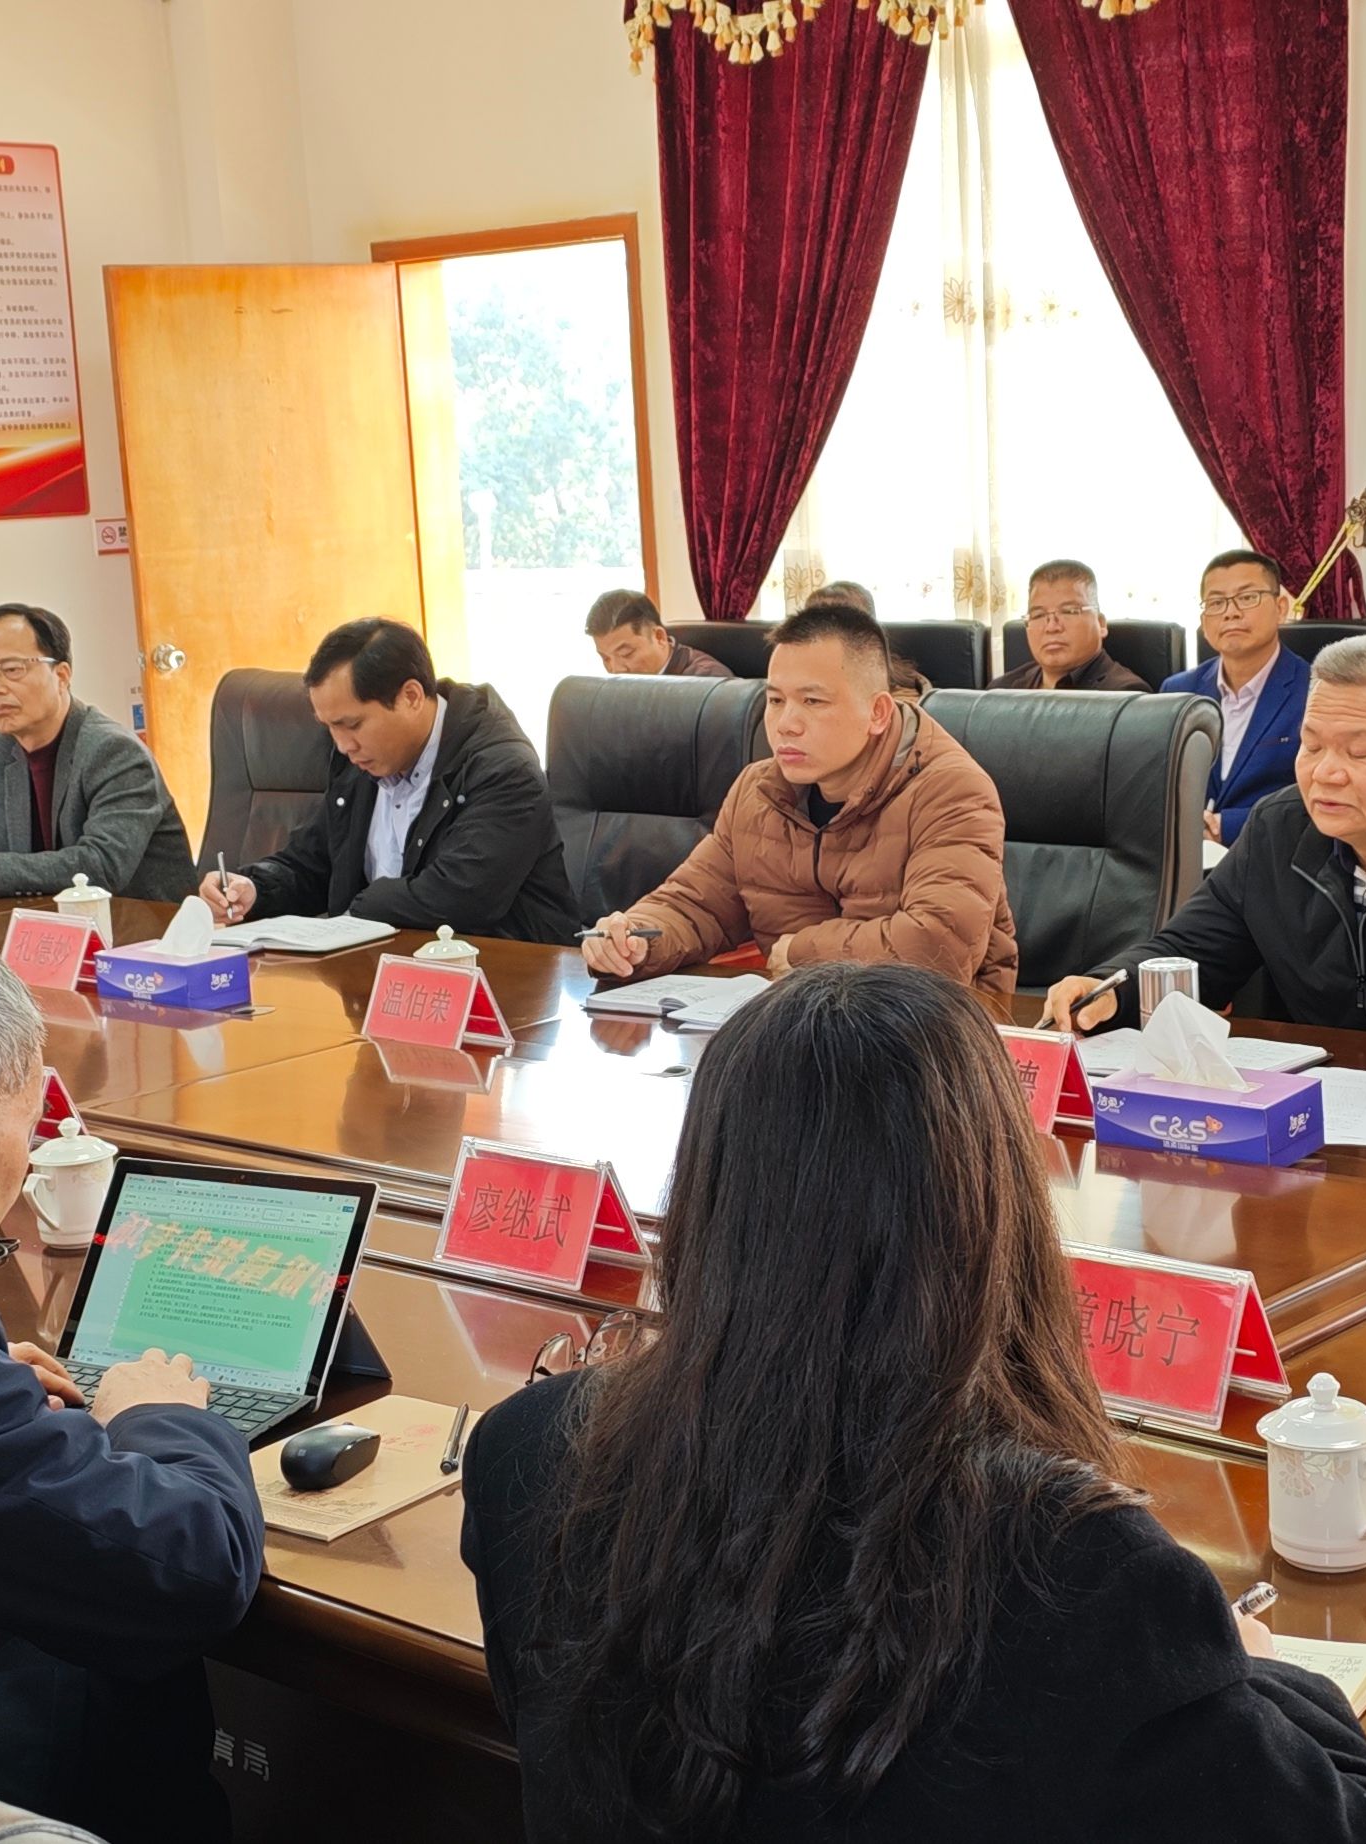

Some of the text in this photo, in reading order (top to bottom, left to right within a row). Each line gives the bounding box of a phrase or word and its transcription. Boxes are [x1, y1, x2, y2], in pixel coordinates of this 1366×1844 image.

[124, 972, 156, 993] C&S
[380, 977, 454, 1025] 温伯荣
[1148, 1113, 1209, 1142] C&S
[461, 1181, 572, 1249] 廖继武
[212, 1727, 270, 1783] 育局
